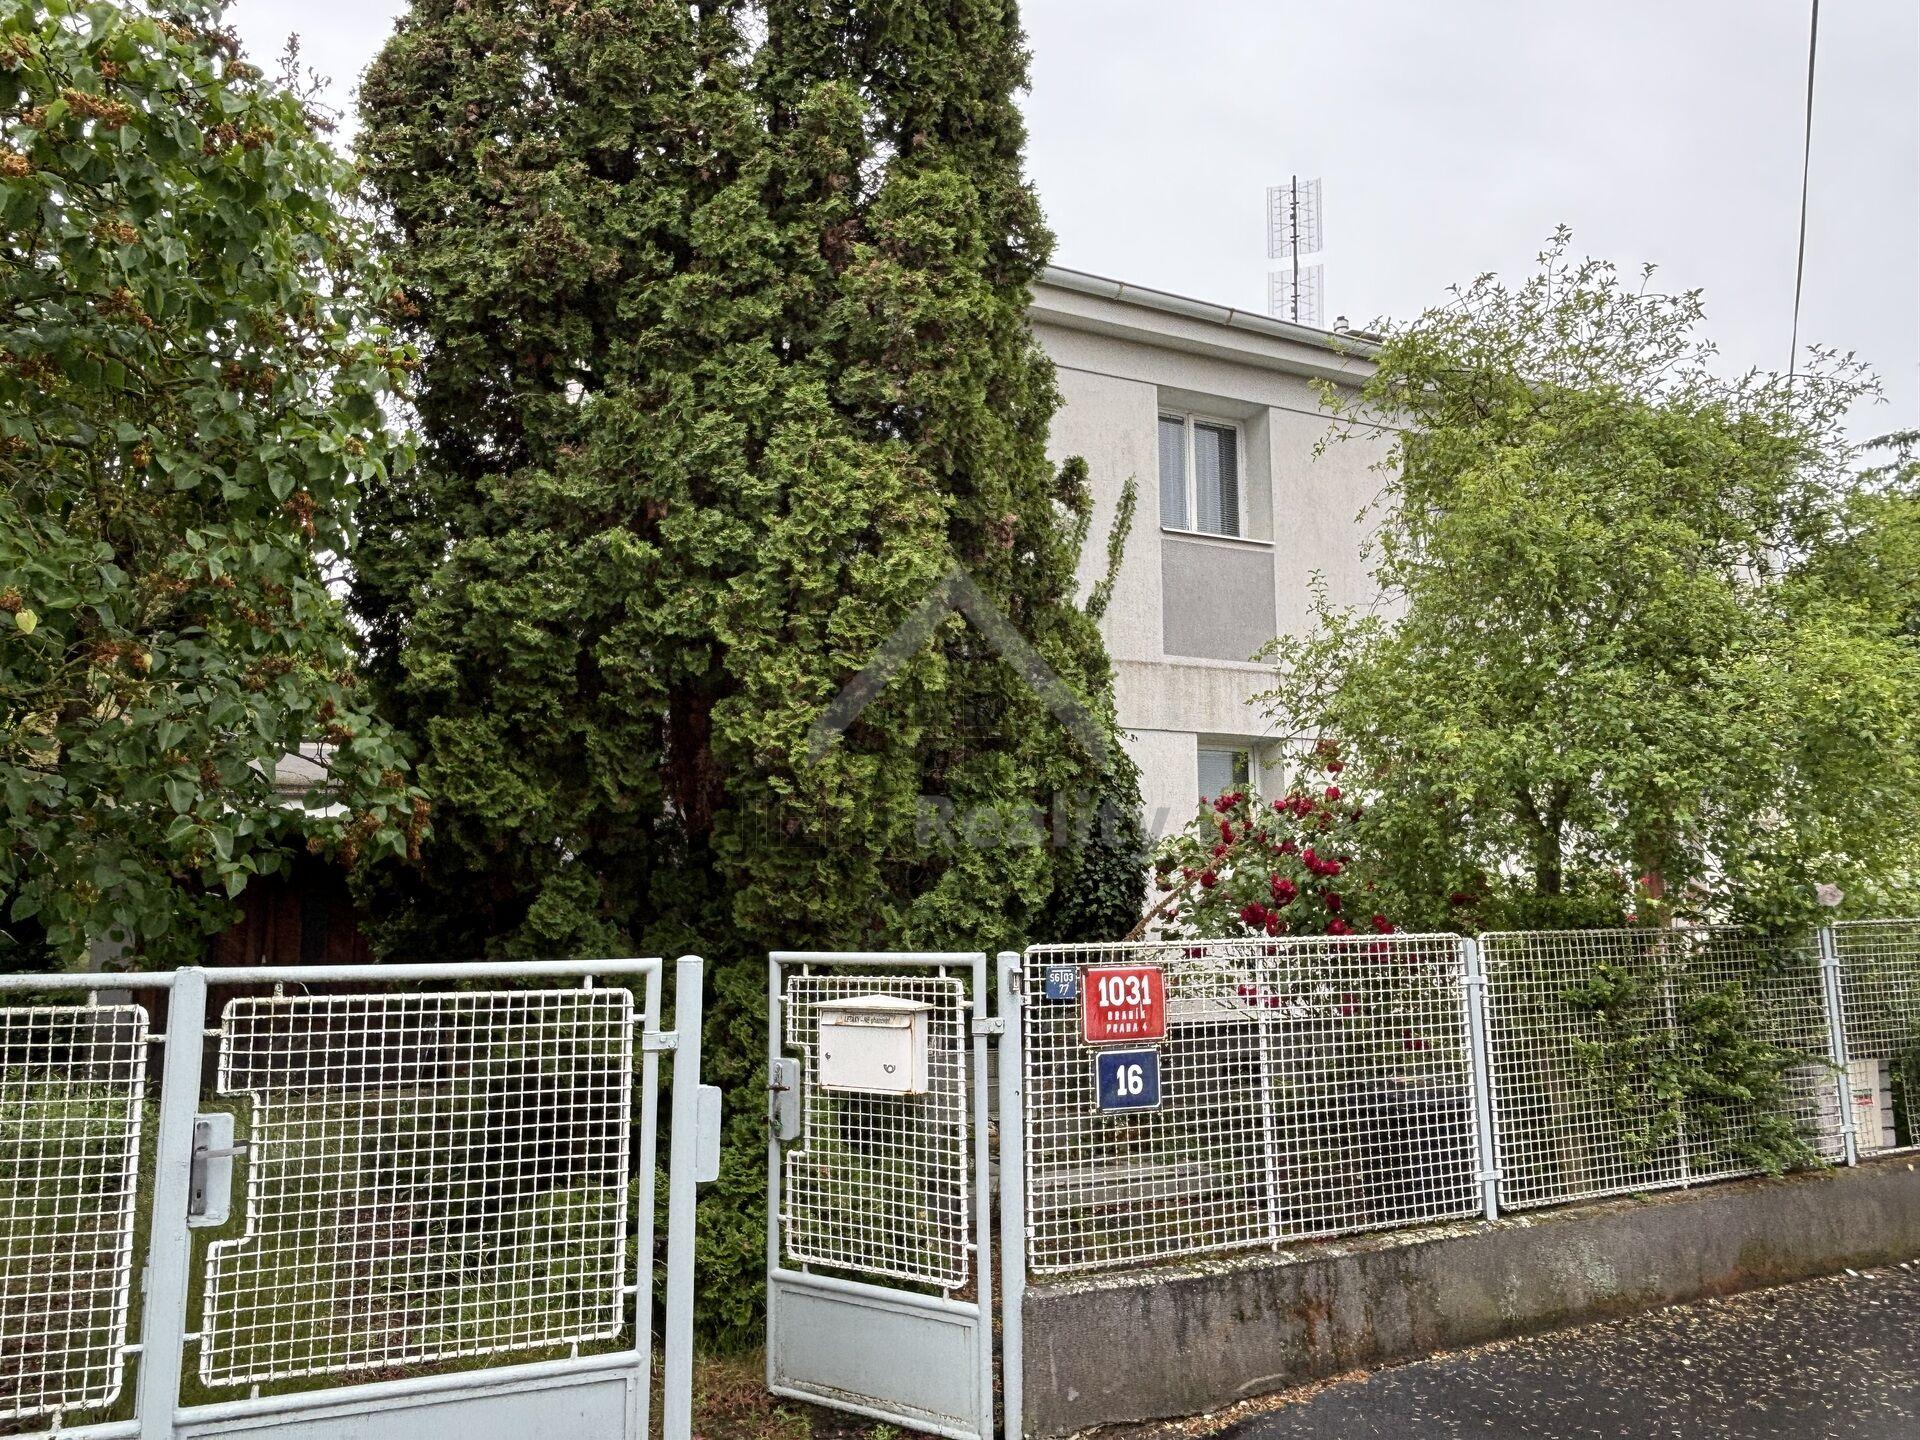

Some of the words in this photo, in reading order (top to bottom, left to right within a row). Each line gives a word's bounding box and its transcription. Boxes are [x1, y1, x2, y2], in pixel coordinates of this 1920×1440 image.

[1098, 975, 1152, 1007] 1031
[1106, 1023, 1139, 1034] PRAHA
[1142, 1022, 1148, 1032] 4
[1116, 1064, 1143, 1096] 16
